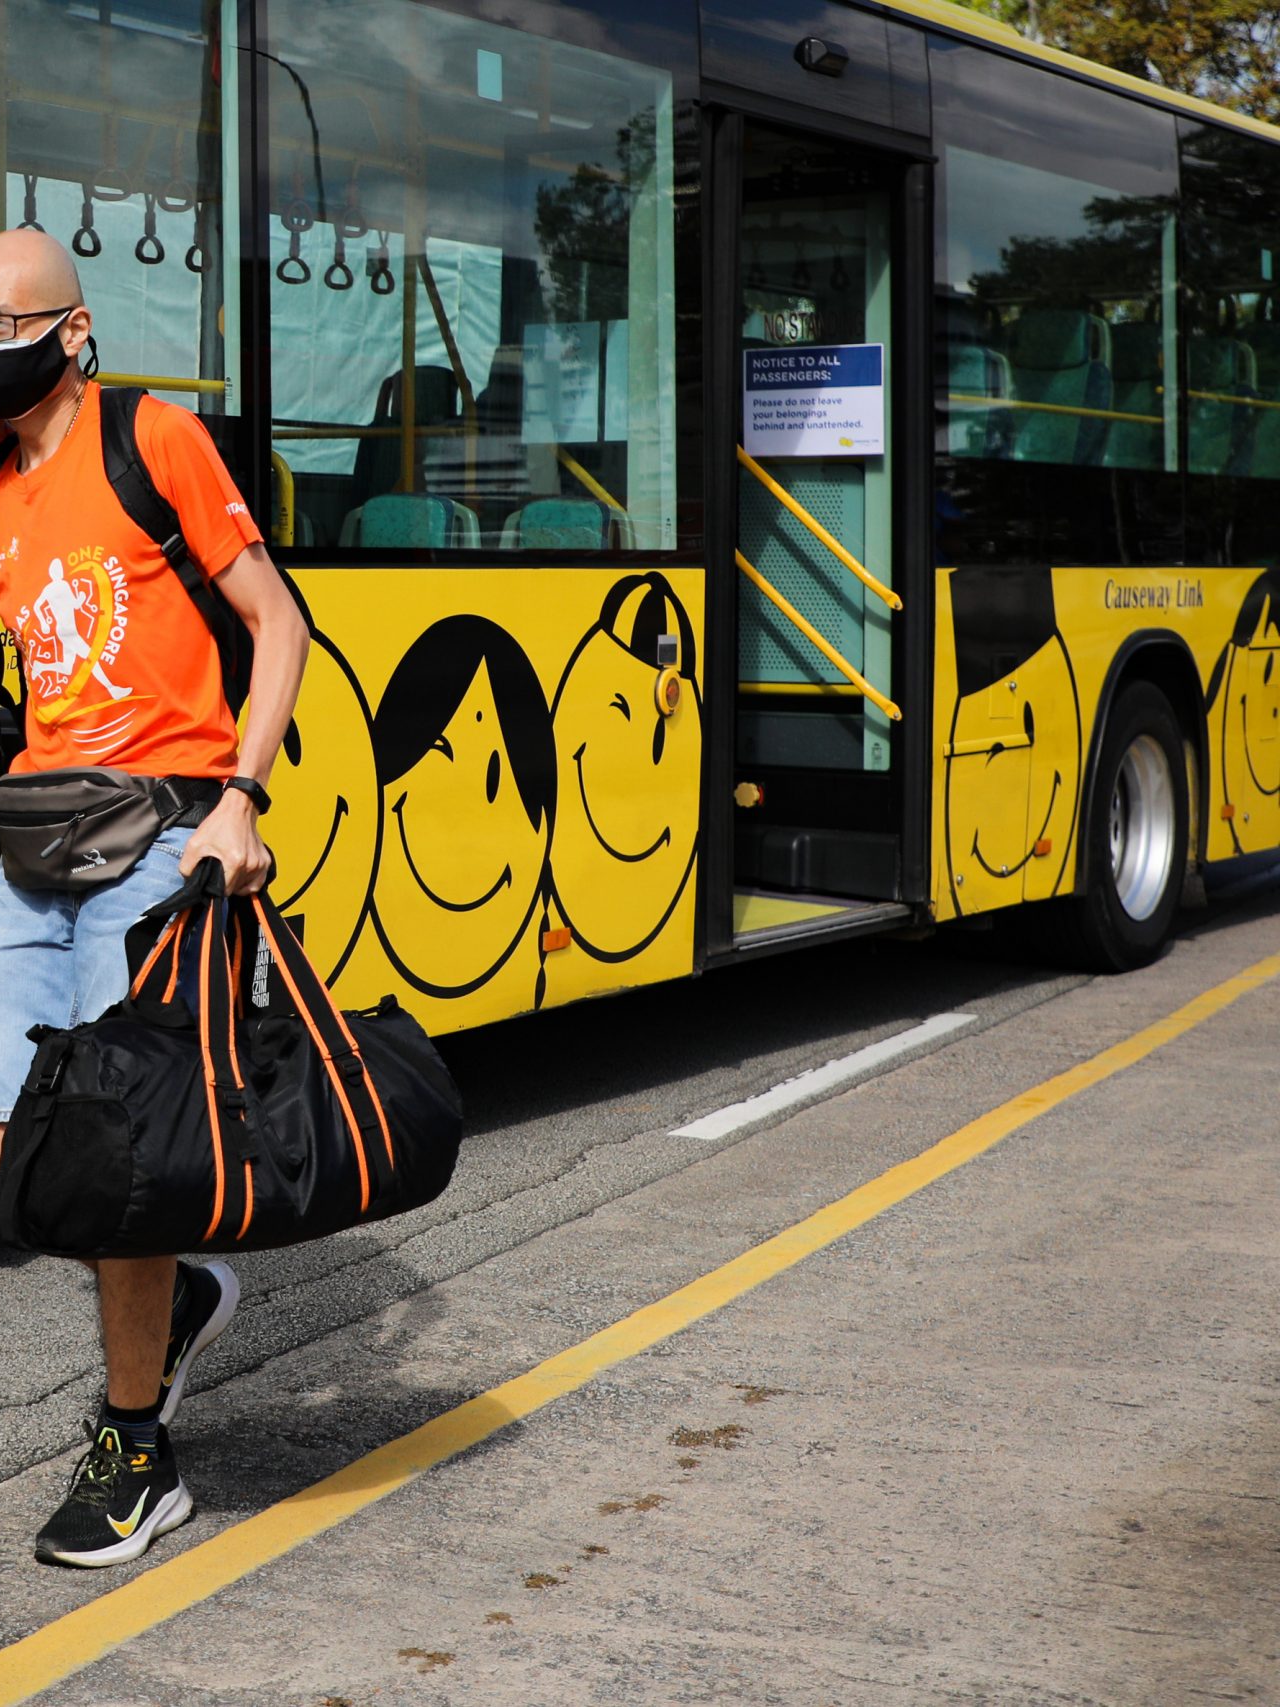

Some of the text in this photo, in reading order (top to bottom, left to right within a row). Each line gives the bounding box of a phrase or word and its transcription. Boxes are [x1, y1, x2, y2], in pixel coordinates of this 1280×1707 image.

[764, 313, 786, 341] NO
[752, 355, 841, 369] NOTICE TO ALL
[752, 370, 832, 383] PASSENGERS:
[752, 397, 842, 407] Please do not leave
[752, 409, 827, 420] your belongings
[753, 420, 864, 431] behind and unattended.
[1105, 579, 1204, 615] Causeway Link
[15, 545, 129, 666] AS ONE SINGAPORE
